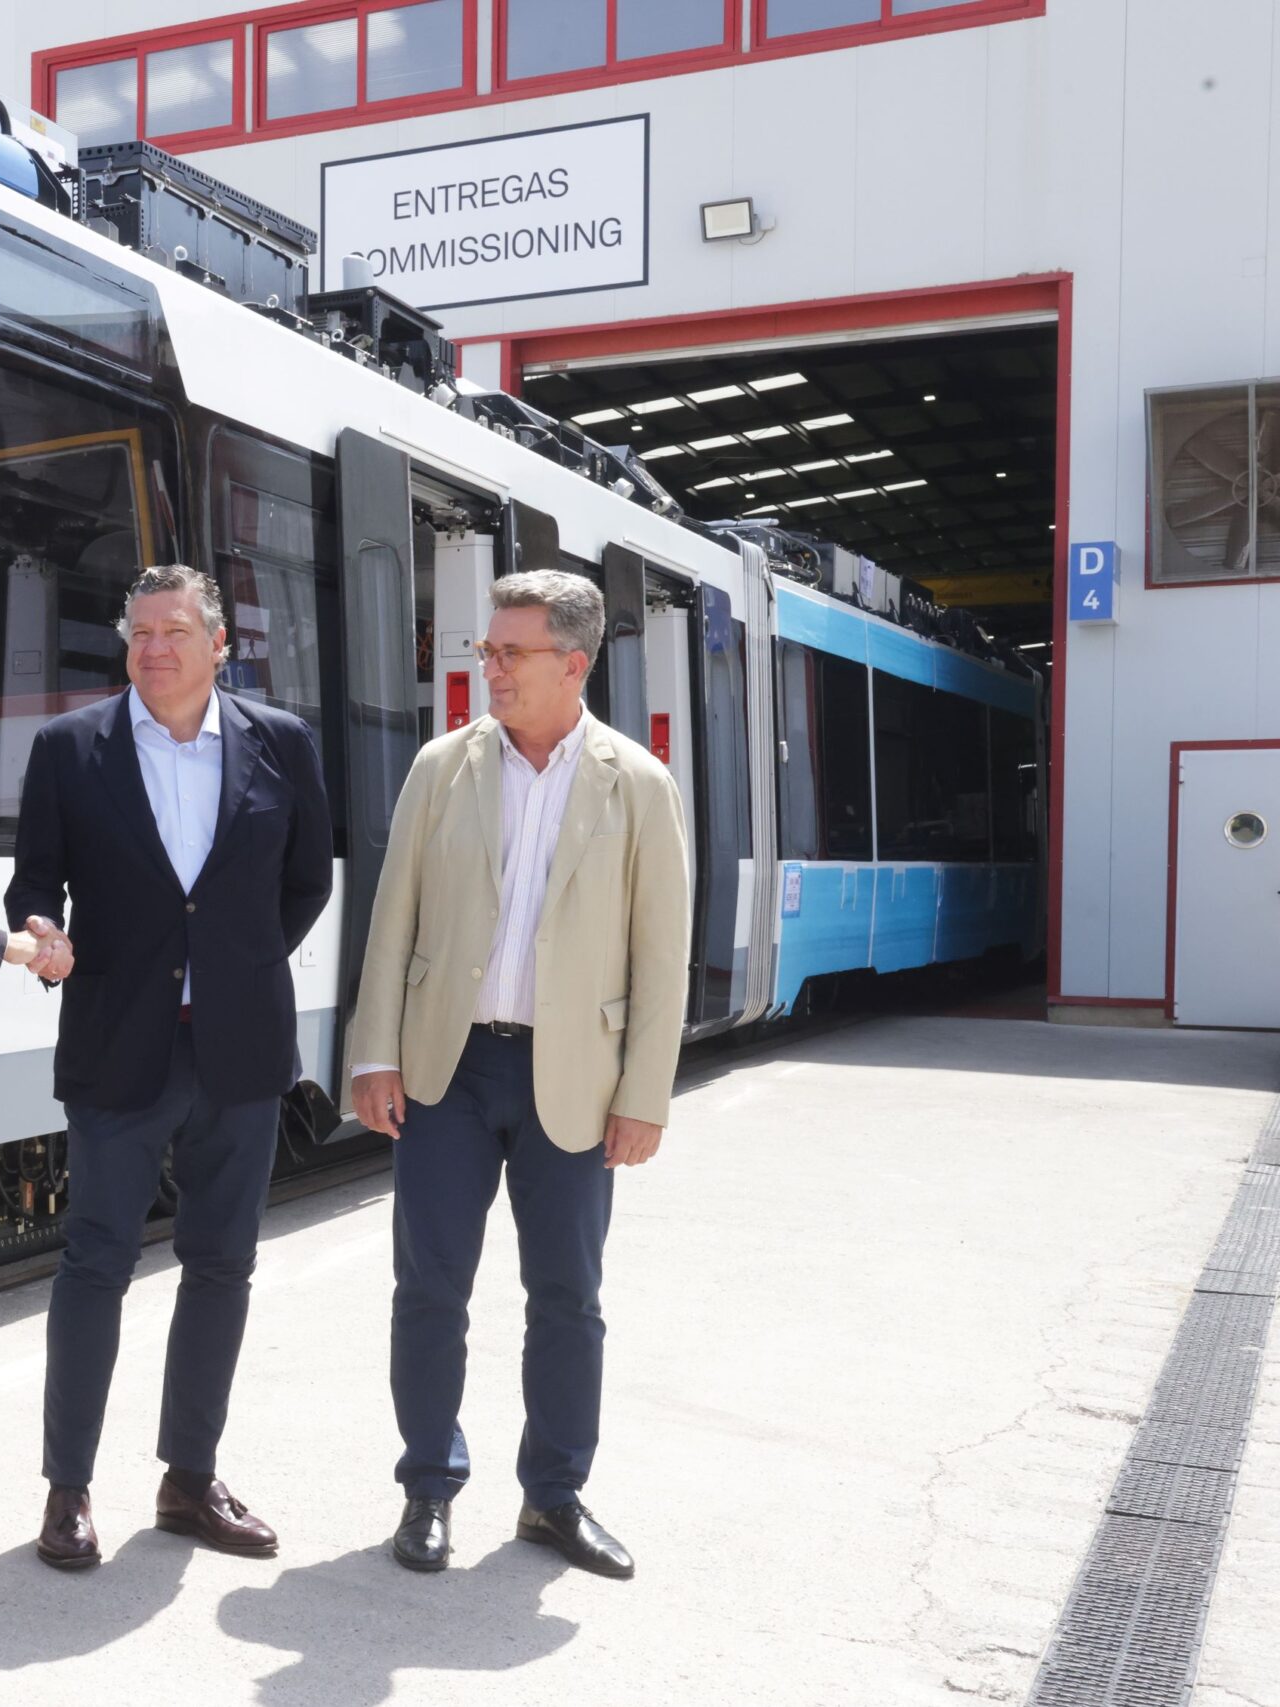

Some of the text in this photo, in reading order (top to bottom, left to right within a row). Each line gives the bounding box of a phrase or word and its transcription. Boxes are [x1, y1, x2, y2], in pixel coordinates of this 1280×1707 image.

[393, 168, 569, 220] ENTREGAS
[349, 217, 622, 278] OMMISSIONING
[1080, 547, 1104, 575] D
[1082, 589, 1100, 610] 4
